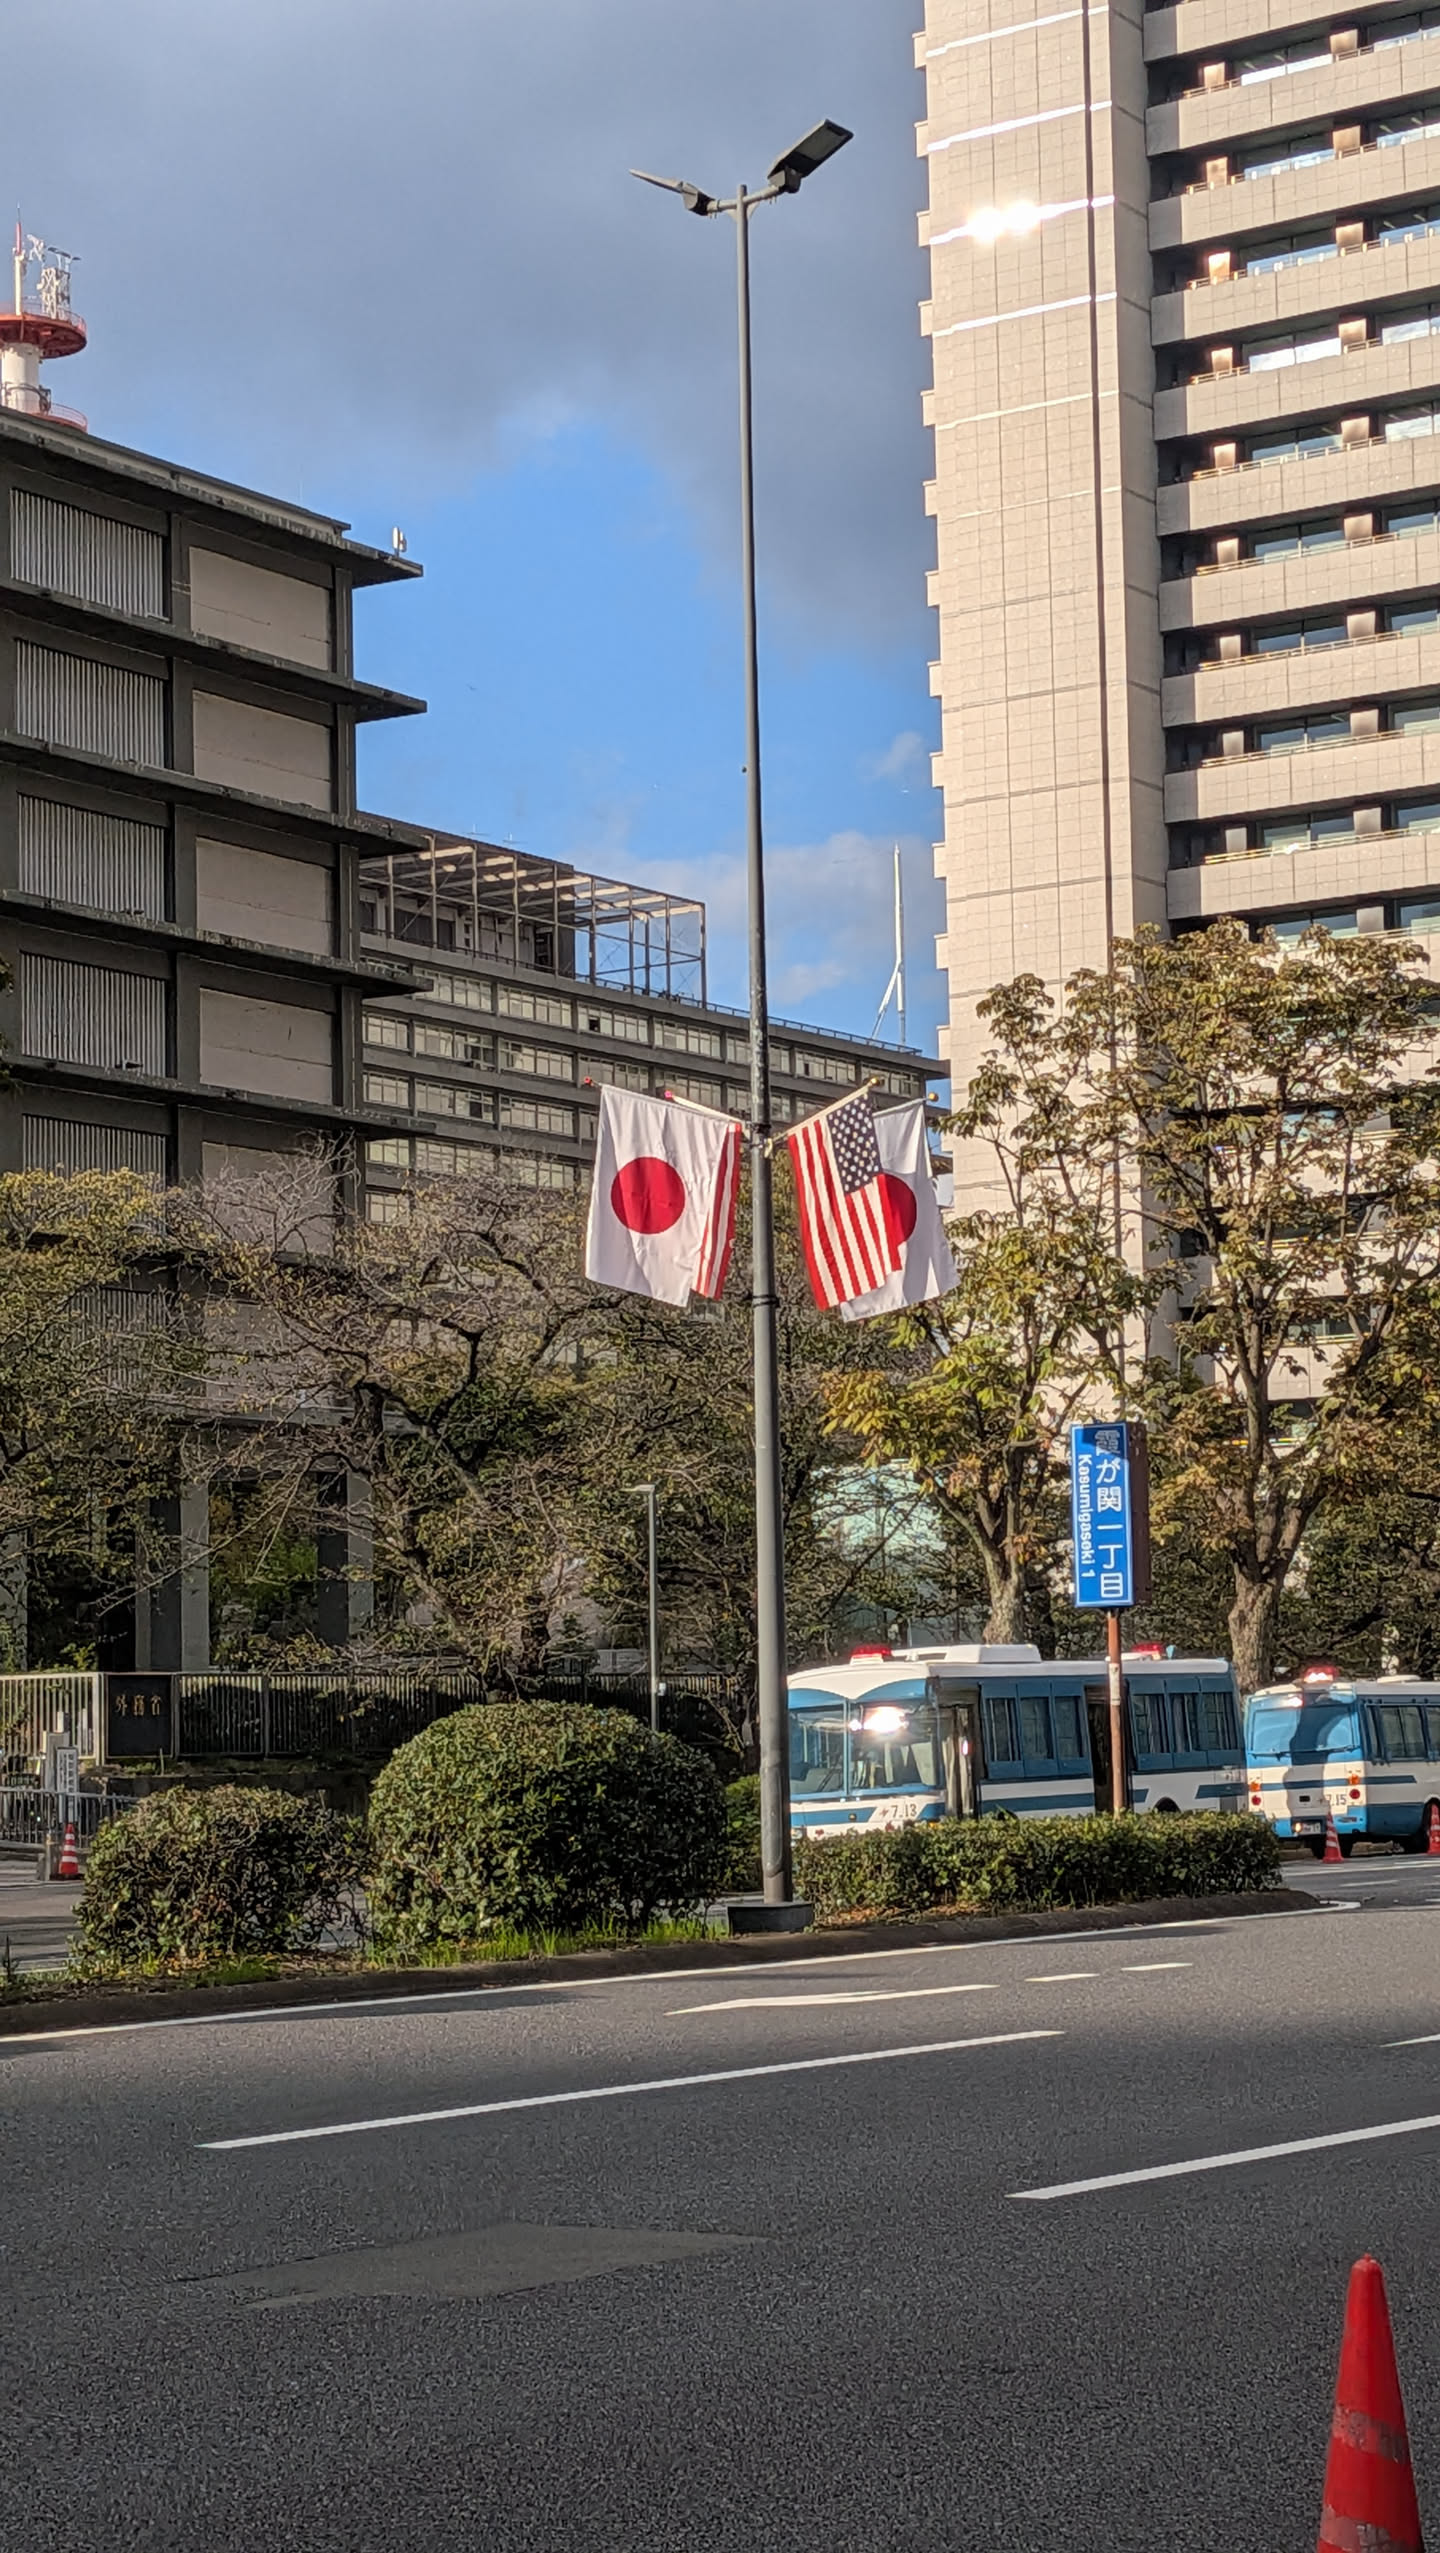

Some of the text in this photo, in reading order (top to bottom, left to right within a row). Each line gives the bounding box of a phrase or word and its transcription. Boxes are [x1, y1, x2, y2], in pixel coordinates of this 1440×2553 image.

[1078, 1453, 1096, 1578] Kasumigaseki 1
[1095, 1429, 1124, 1598] 霞が関一丁目
